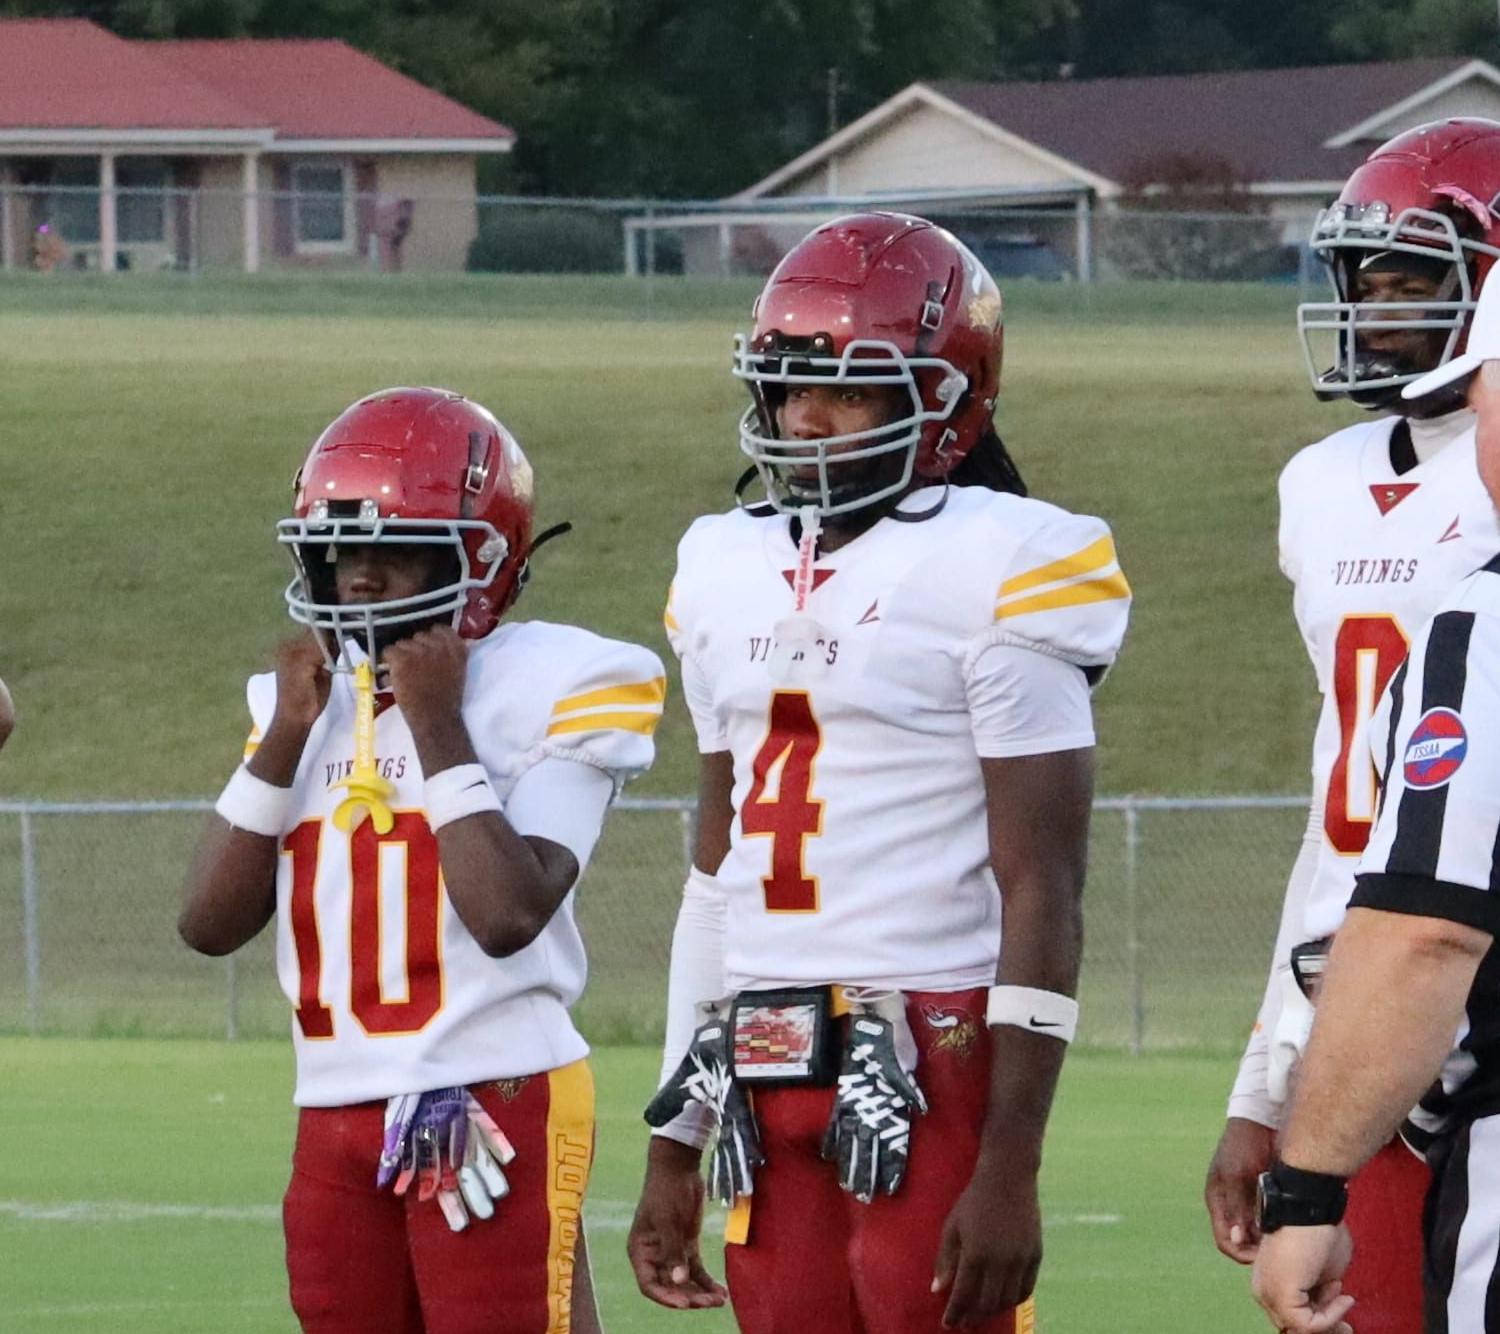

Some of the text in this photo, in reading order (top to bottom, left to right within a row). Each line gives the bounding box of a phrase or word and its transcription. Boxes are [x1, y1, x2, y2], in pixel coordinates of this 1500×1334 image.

[1335, 558, 1419, 586] VIKINGS
[740, 688, 826, 915] 4
[279, 807, 447, 1042] 10
